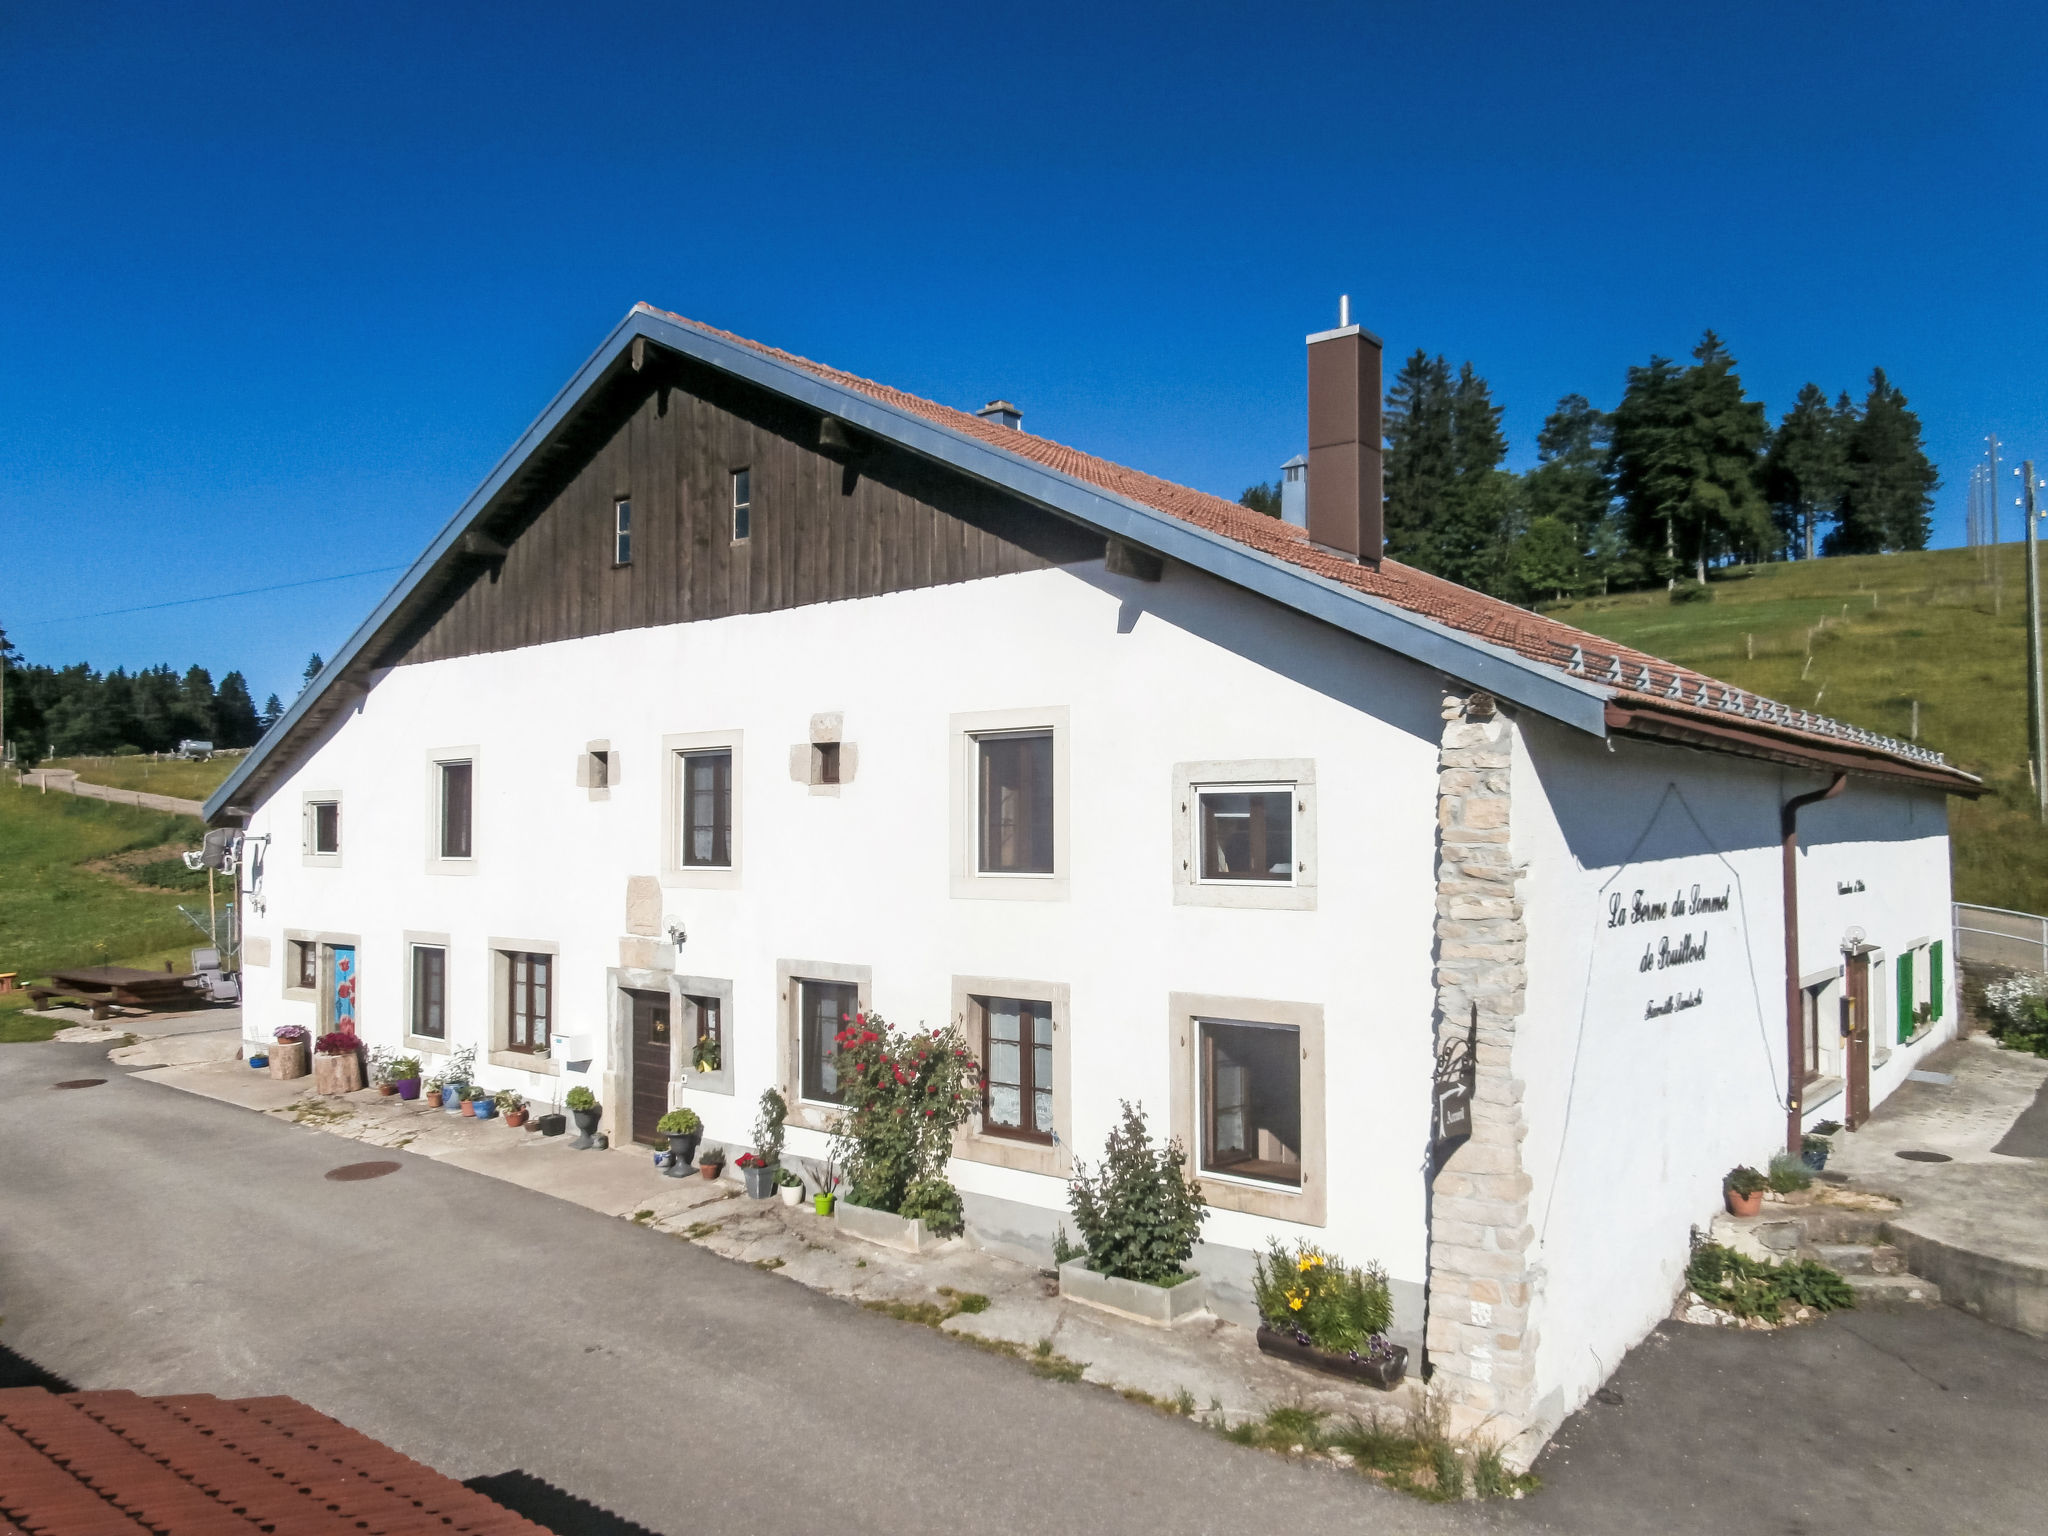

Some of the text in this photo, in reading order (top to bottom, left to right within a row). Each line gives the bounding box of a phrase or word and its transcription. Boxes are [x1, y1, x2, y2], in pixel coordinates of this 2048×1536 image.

[1608, 884, 1730, 928] La Ferme du Sommet
[1639, 943, 1654, 973] de
